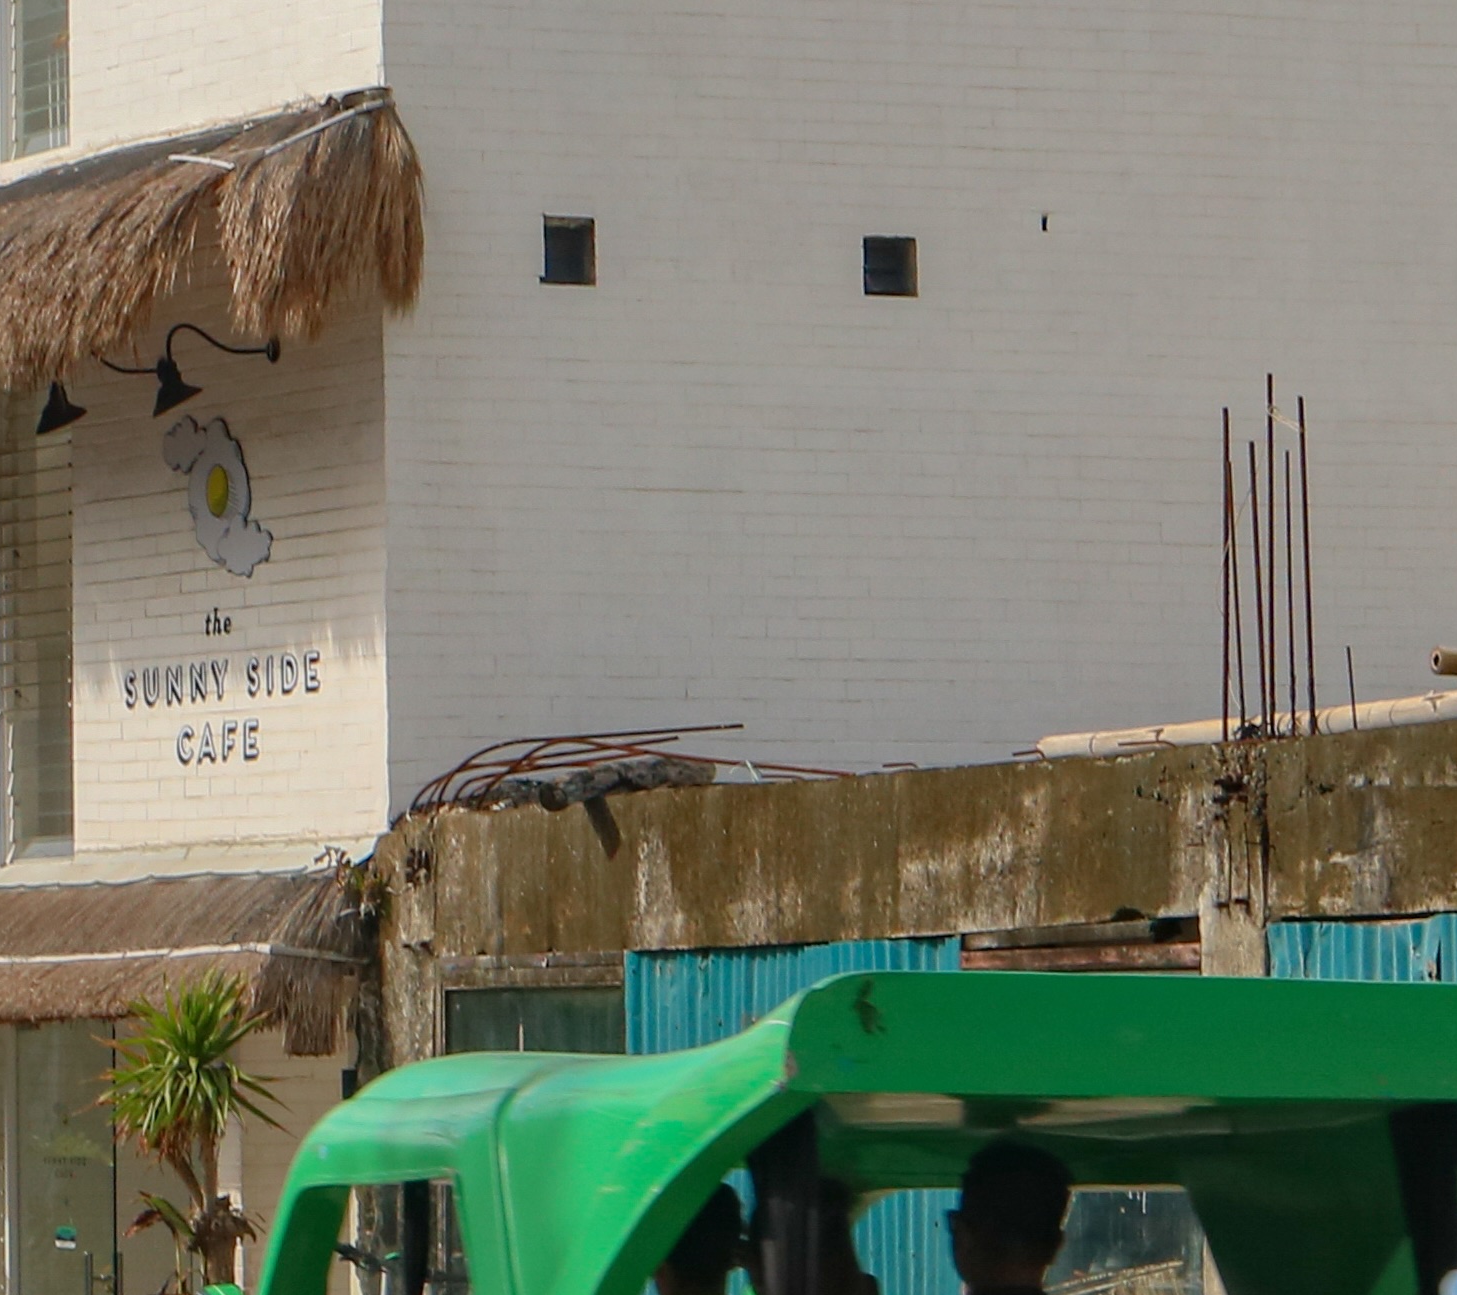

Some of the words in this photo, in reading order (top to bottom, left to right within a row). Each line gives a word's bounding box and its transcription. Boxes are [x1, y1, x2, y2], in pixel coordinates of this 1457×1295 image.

[204, 607, 232, 636] the
[124, 659, 229, 709] SUNNY
[247, 650, 321, 698] SIDE
[176, 718, 260, 766] CAFE
